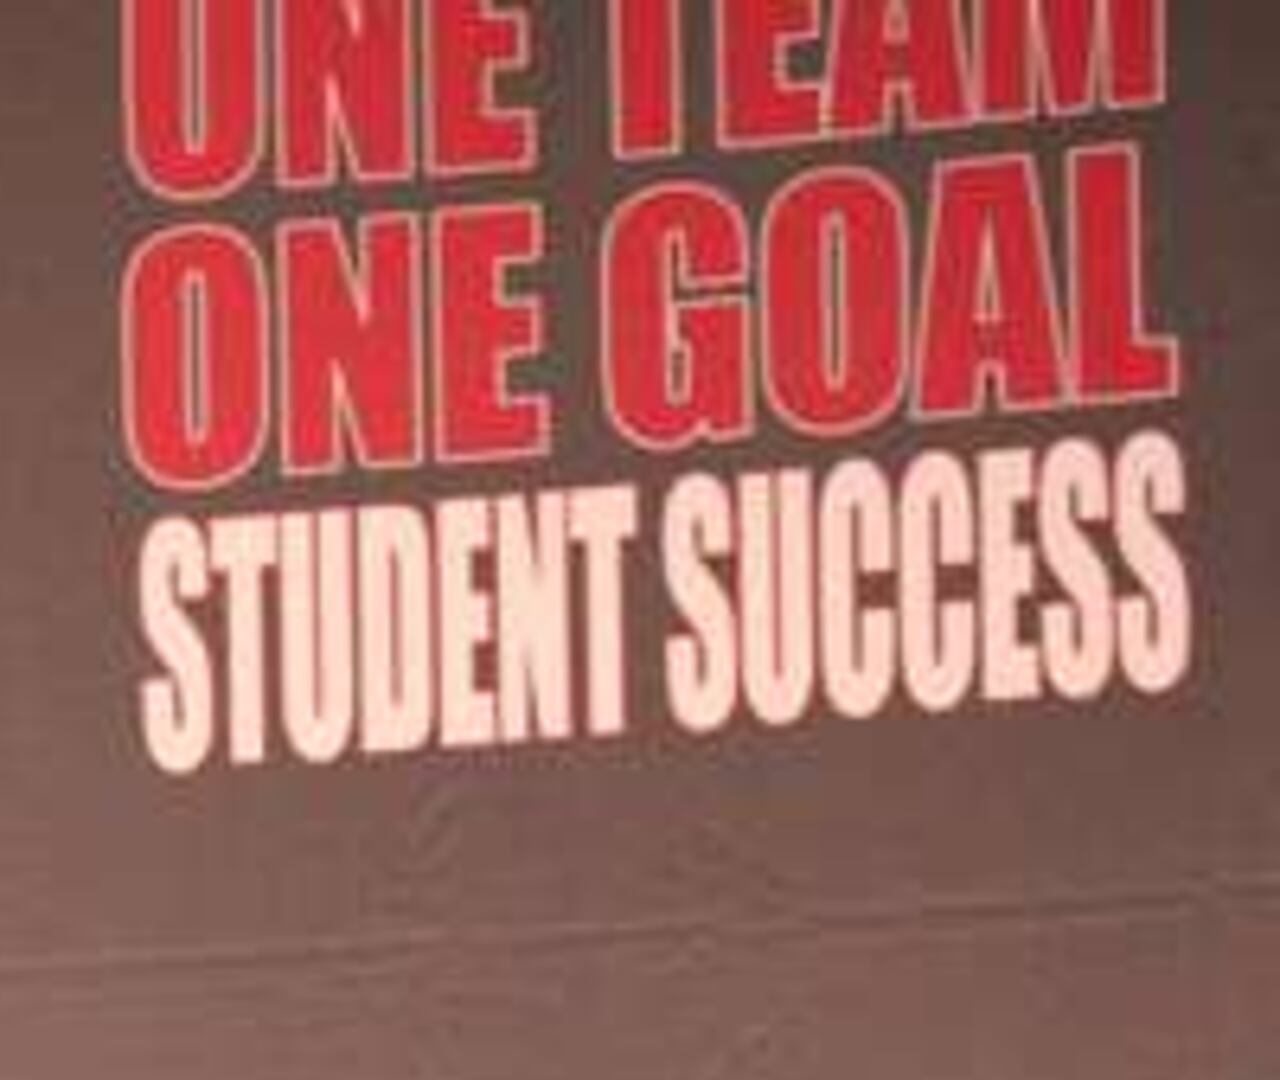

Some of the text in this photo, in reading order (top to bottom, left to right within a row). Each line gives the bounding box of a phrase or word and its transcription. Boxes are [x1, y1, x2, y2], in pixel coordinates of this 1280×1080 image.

[122, 0, 539, 199] ONE
[120, 141, 1180, 492] ONE GOAL
[139, 429, 1193, 775] STUDENT SUCCESS
